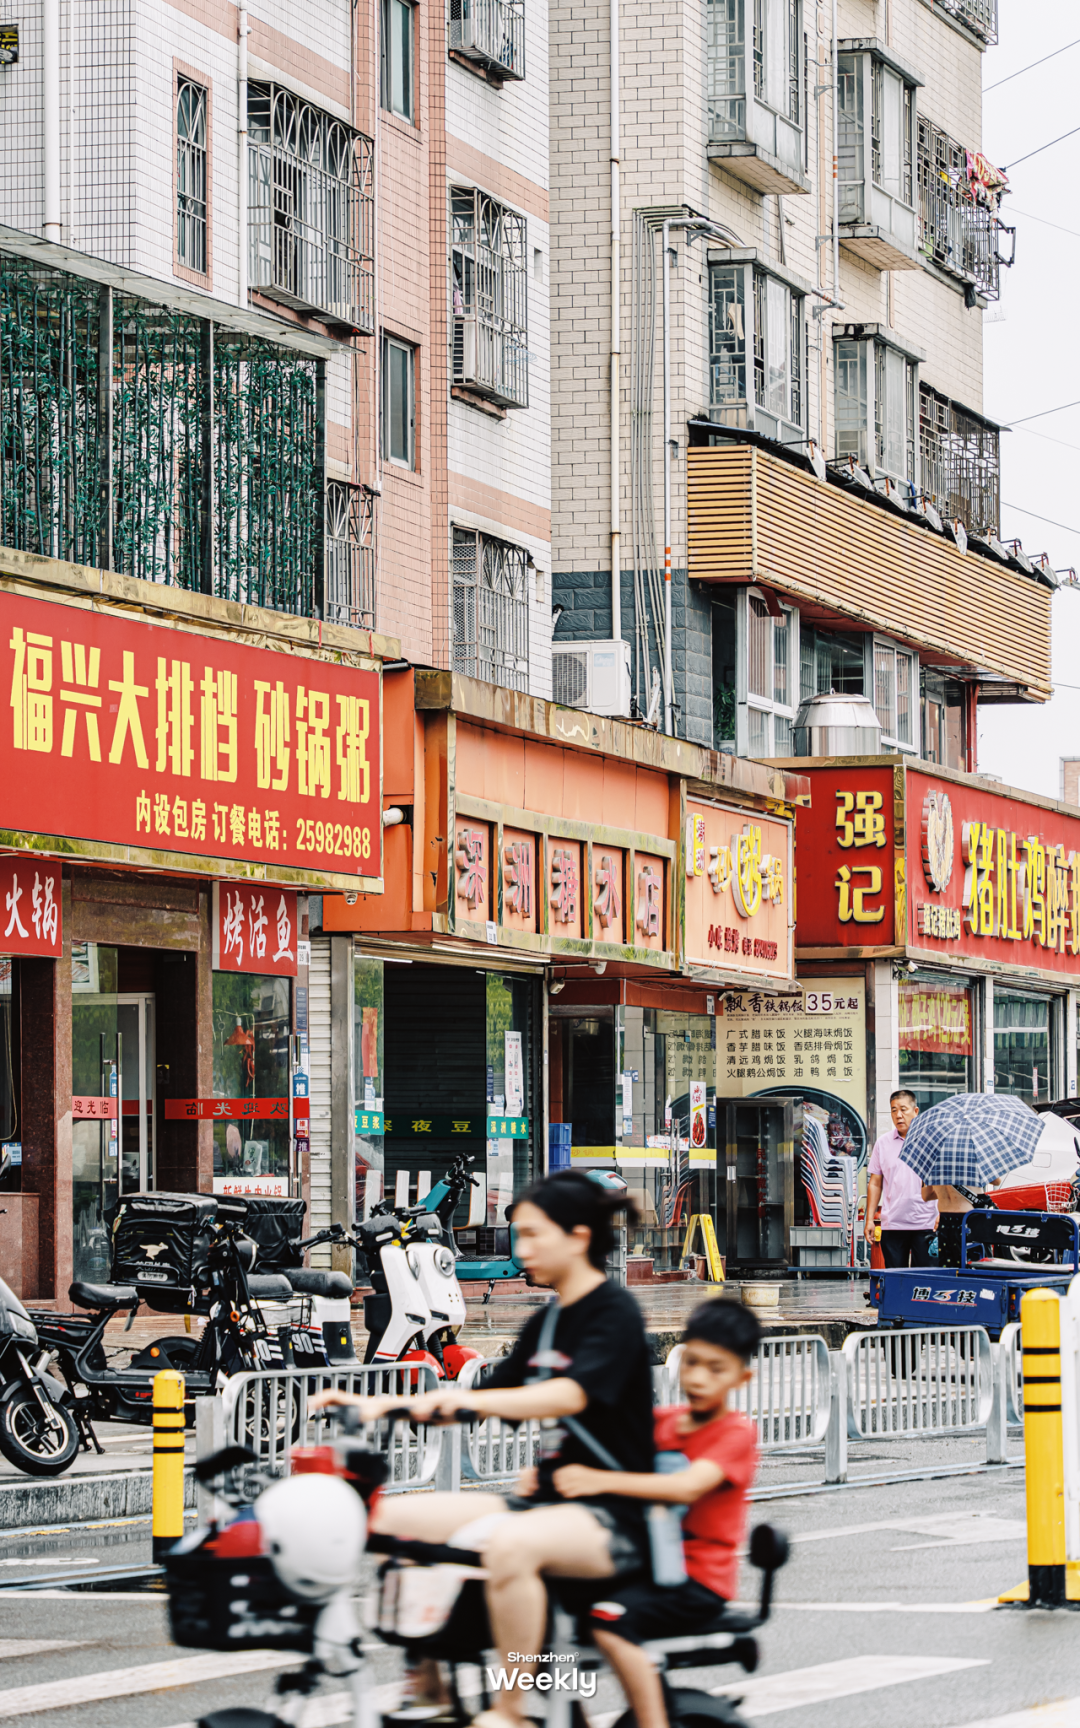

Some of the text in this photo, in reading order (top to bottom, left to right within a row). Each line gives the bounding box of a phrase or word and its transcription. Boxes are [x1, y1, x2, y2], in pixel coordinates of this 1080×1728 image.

[9, 626, 371, 804] 福兴大排档 砂锅粥
[135, 789, 208, 842] 内设包房
[834, 790, 887, 923] 强记
[4, 870, 58, 947] 火锅
[222, 889, 295, 967] 烤活鱼
[724, 992, 804, 1013] 飘香铁锅饭
[726, 1028, 787, 1040] 广式腊味饭
[793, 1027, 854, 1039] 火腿海味焗饭
[726, 1040, 854, 1053] 香芋腊味饭 香菇排骨焗饭
[726, 1053, 854, 1066] 清远鸡焗饭 乳鸽焗饭
[726, 1065, 854, 1079] 火腿鹅公焗饭 油鸭焗饭
[292, 1333, 315, 1355] 90
